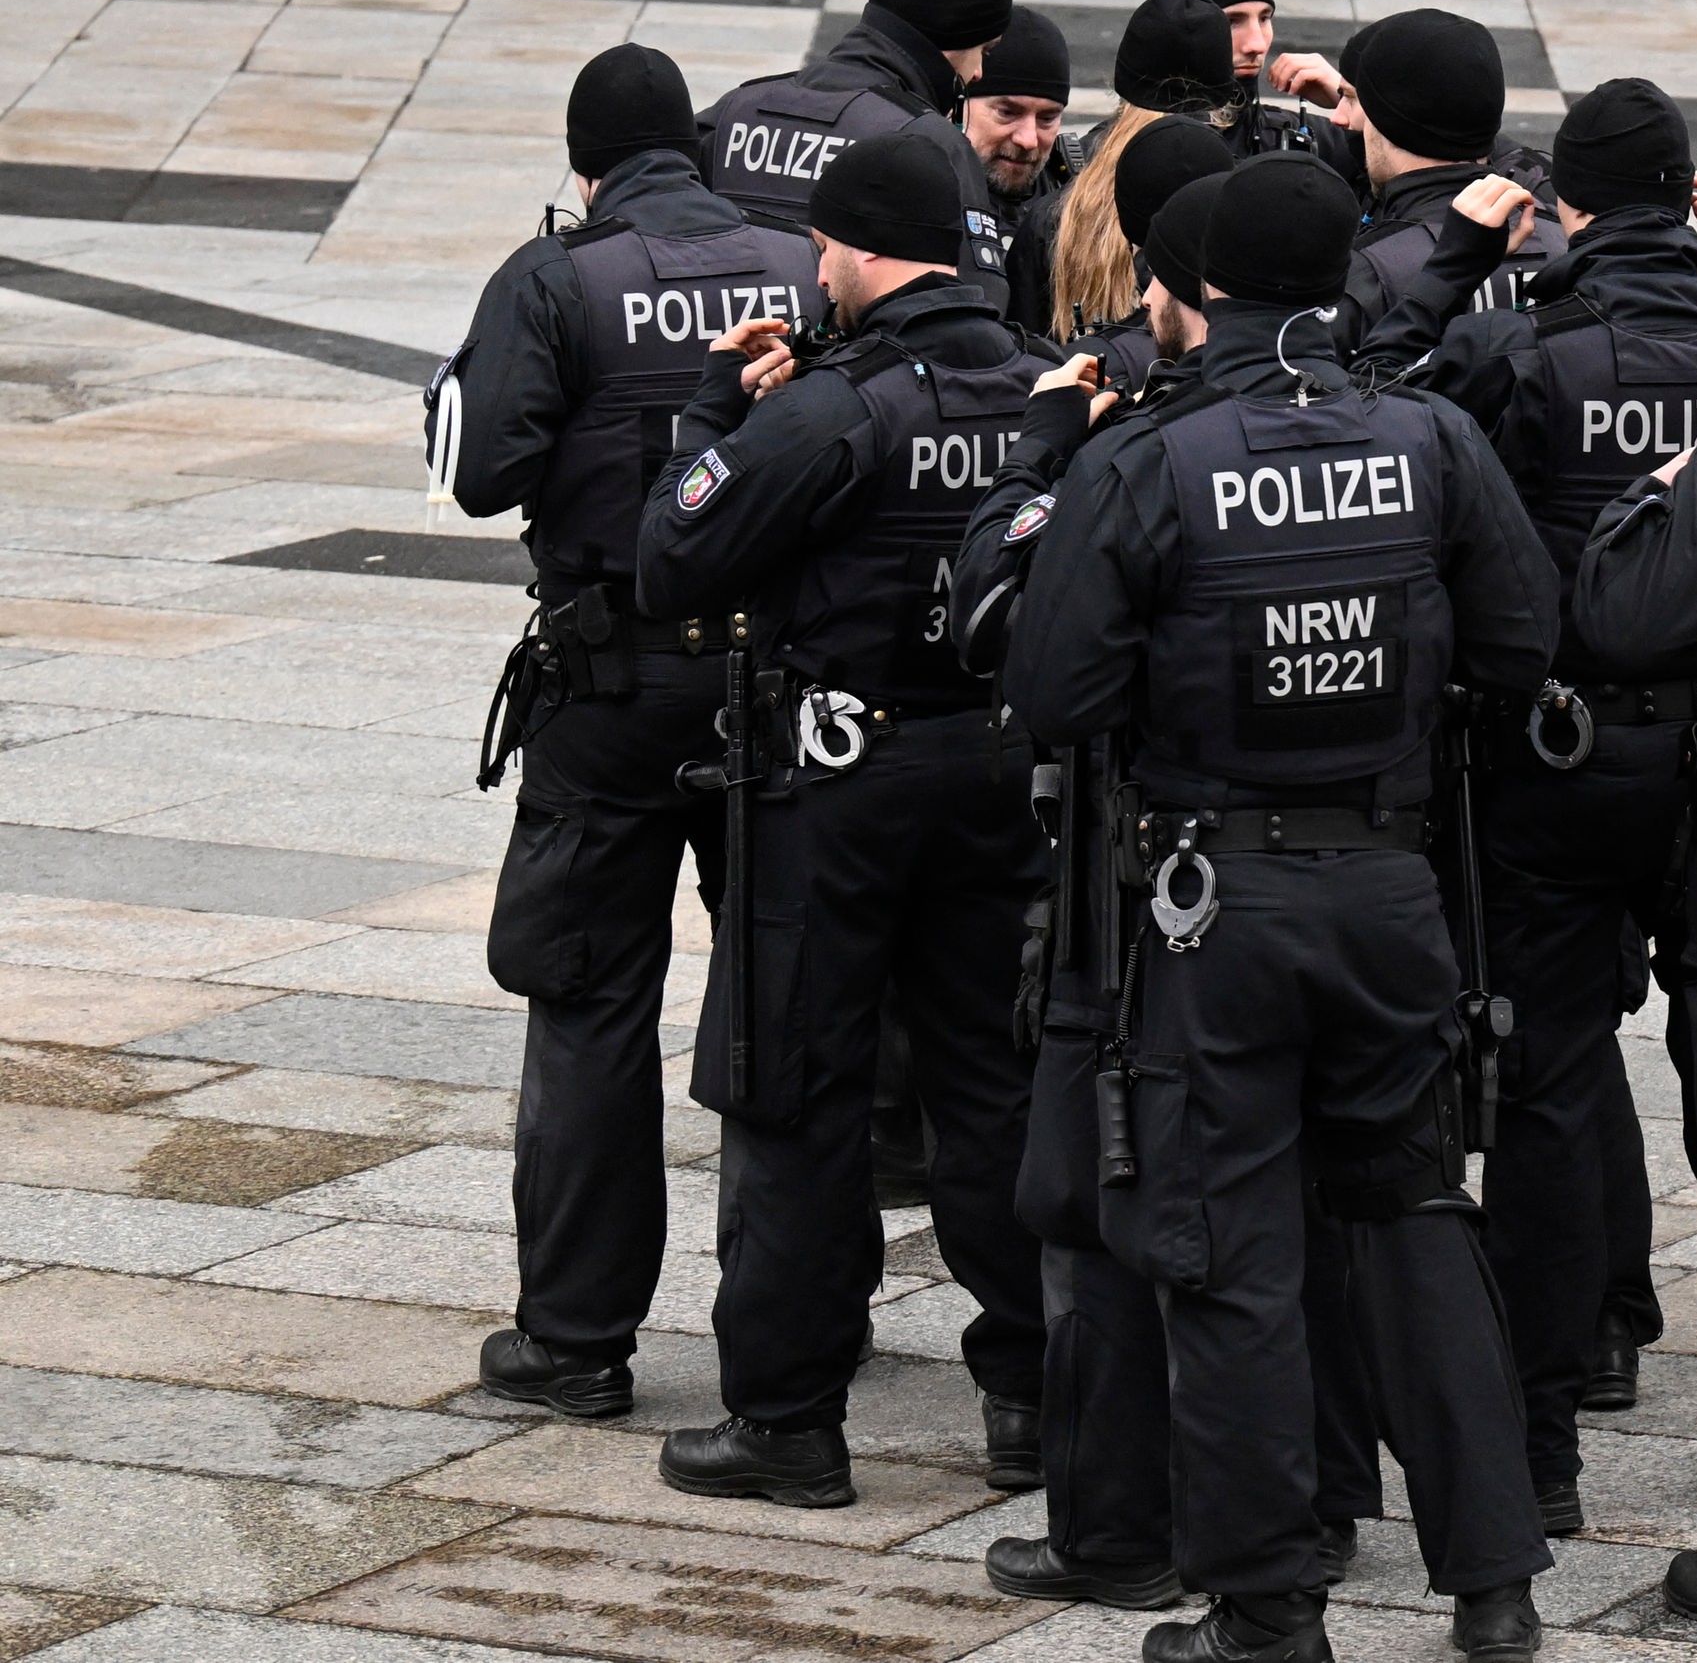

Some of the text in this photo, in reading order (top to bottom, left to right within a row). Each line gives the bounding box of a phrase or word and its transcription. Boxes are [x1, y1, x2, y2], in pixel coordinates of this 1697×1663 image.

[724, 122, 856, 181] POLIZE
[909, 431, 1021, 489] POLI
[1212, 454, 1414, 530] POLIZEI
[1265, 595, 1377, 647] NRW
[1267, 646, 1383, 697] 31221
